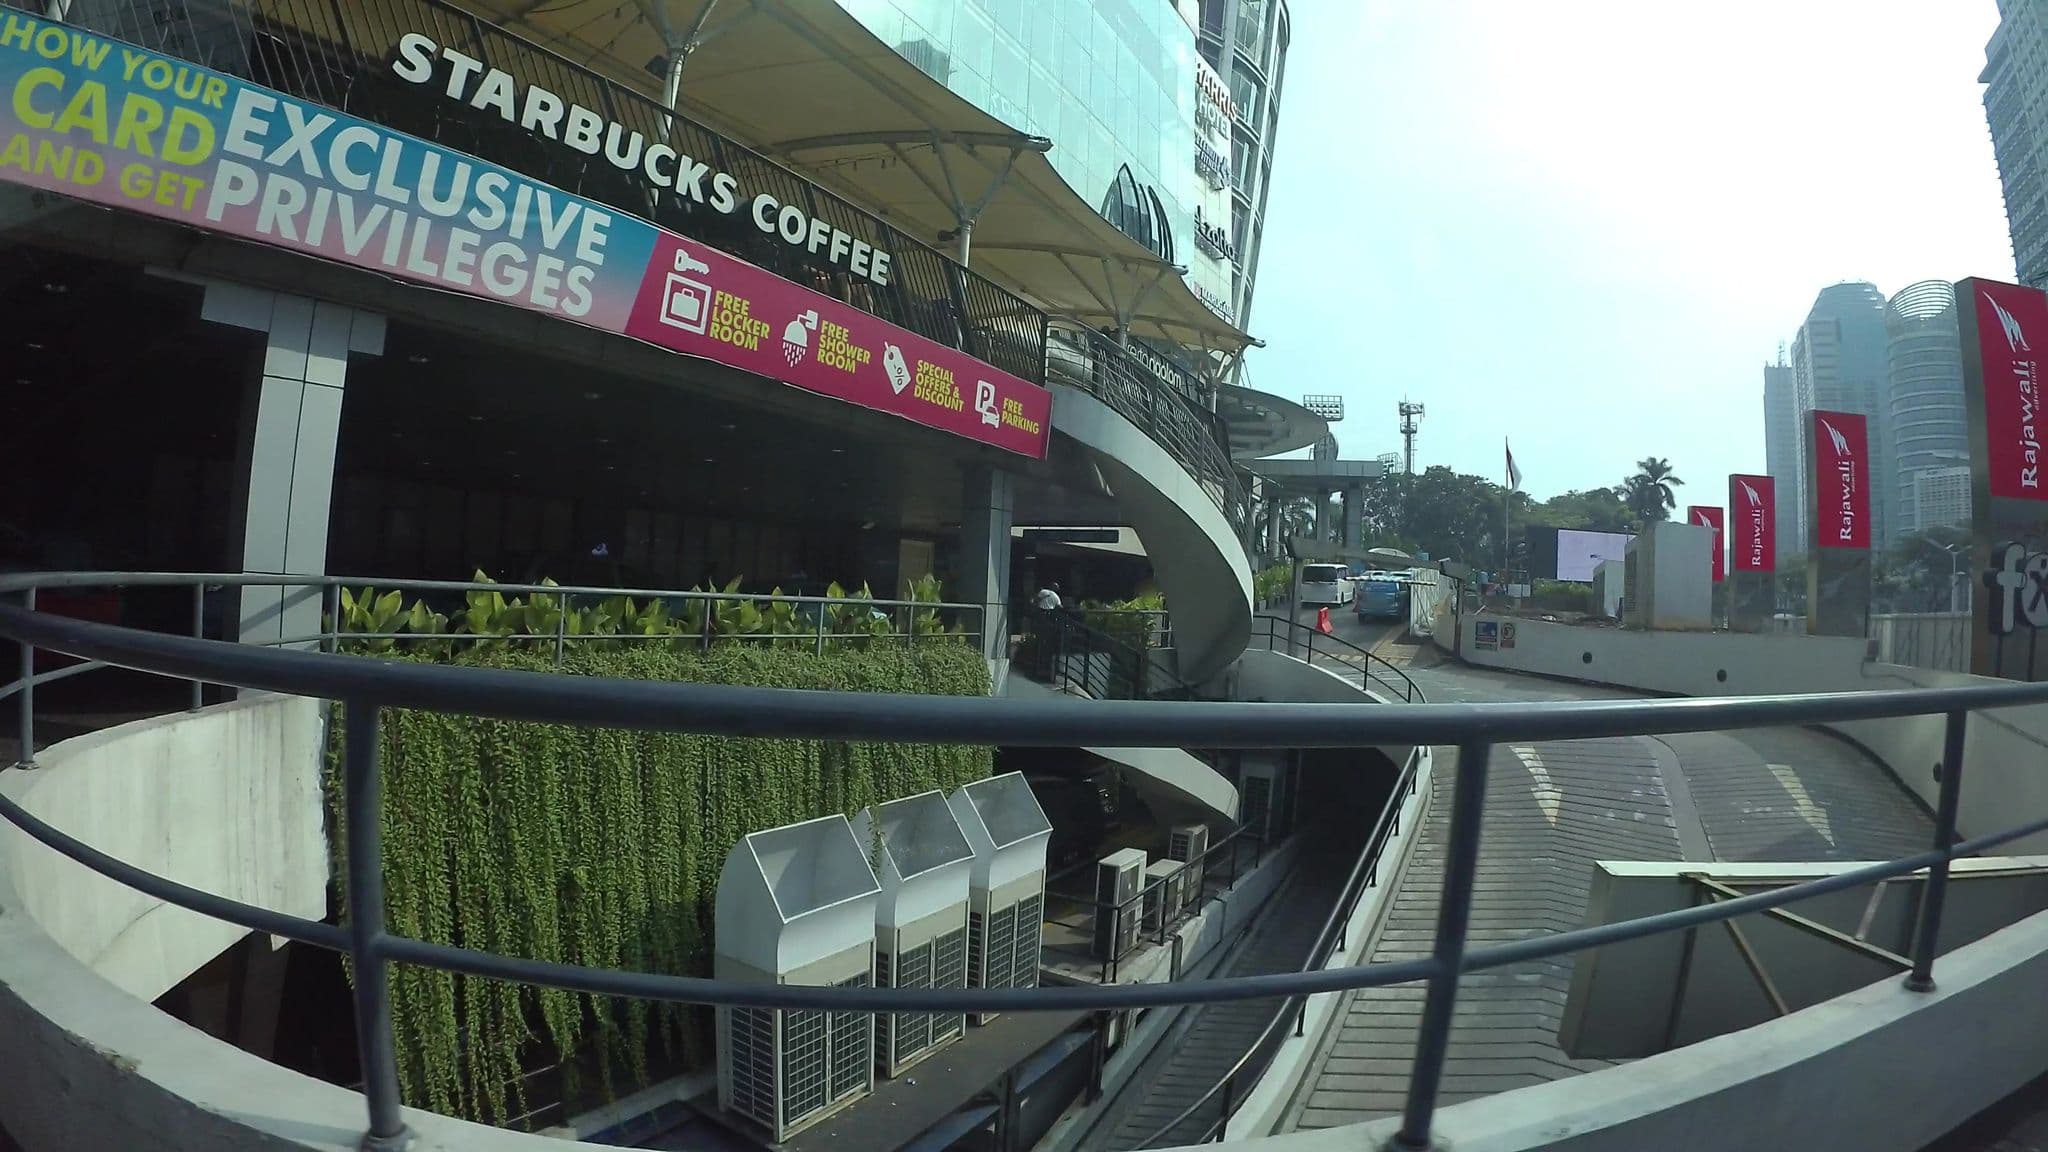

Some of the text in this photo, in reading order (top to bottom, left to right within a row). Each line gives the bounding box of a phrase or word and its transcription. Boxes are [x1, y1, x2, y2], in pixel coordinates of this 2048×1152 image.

[0, 12, 229, 109] HOW YOUR
[12, 67, 216, 166] CARD
[0, 133, 205, 212] AND GET
[391, 32, 891, 286] STARBUCKS COFFEE
[223, 88, 612, 265] EXCLUSIVE
[205, 159, 596, 317] PRIVILEGES
[714, 290, 750, 316] FREE
[709, 322, 758, 351] ROOM
[711, 307, 770, 339] LOCKER
[821, 320, 849, 342] FREE
[817, 348, 856, 374] ROOM
[818, 334, 871, 364] SHOWER
[915, 373, 960, 399] OFFERS &
[916, 360, 954, 385] SPECIAL
[913, 384, 965, 412] DISCOUNT
[1003, 397, 1024, 415] FREE
[1001, 411, 1040, 434] PARKING
[2011, 360, 2041, 489] Rajawali
[1838, 460, 1854, 540] Rajawali
[1751, 509, 1763, 566] Rajawali
